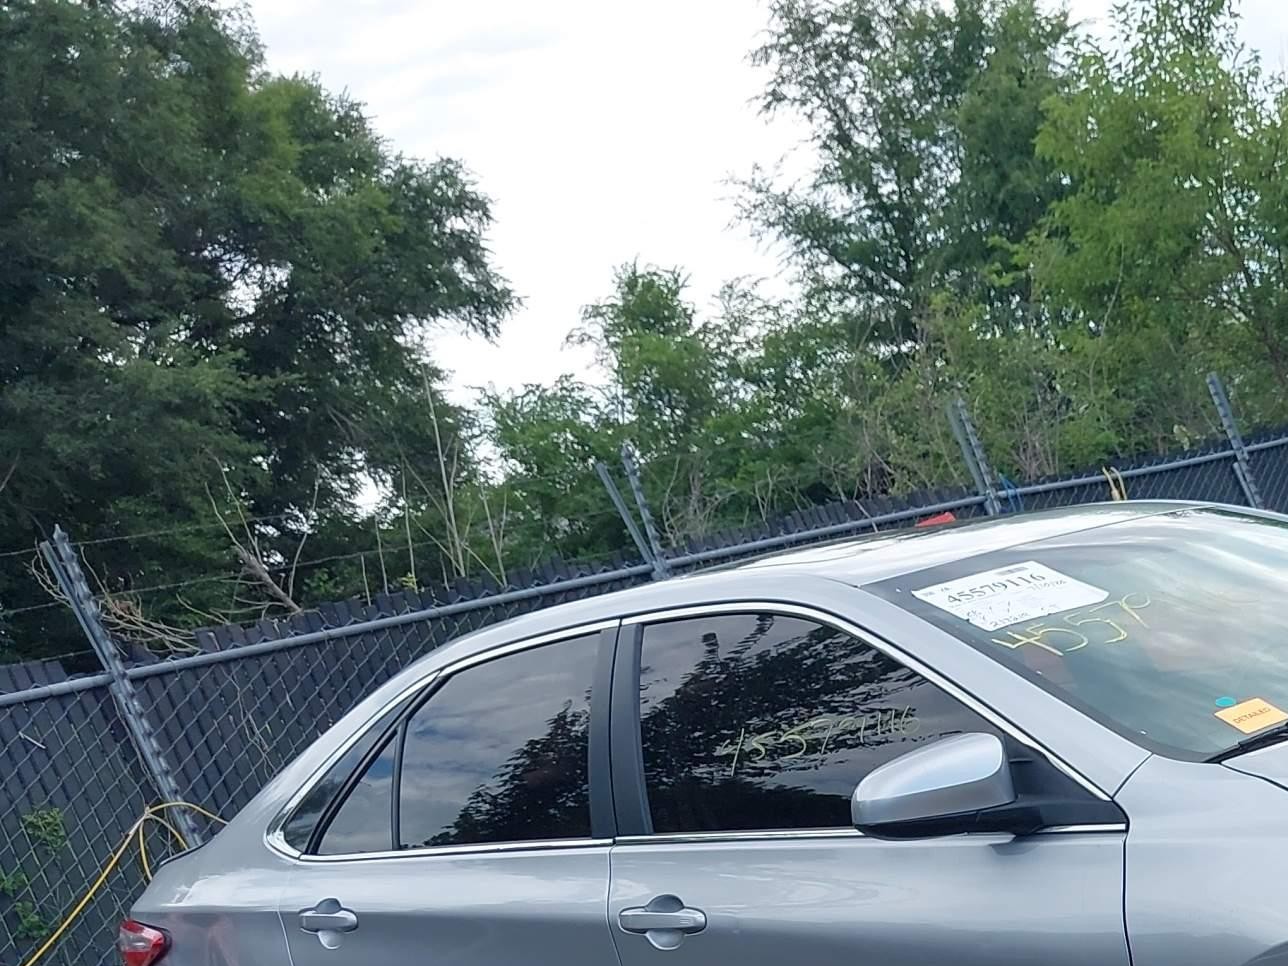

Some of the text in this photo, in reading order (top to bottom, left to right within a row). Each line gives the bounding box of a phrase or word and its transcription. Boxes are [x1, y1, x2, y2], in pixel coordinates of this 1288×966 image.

[946, 573, 1047, 605] 45579116
[1232, 706, 1272, 724] DETAILED
[713, 704, 921, 777] 45579116
